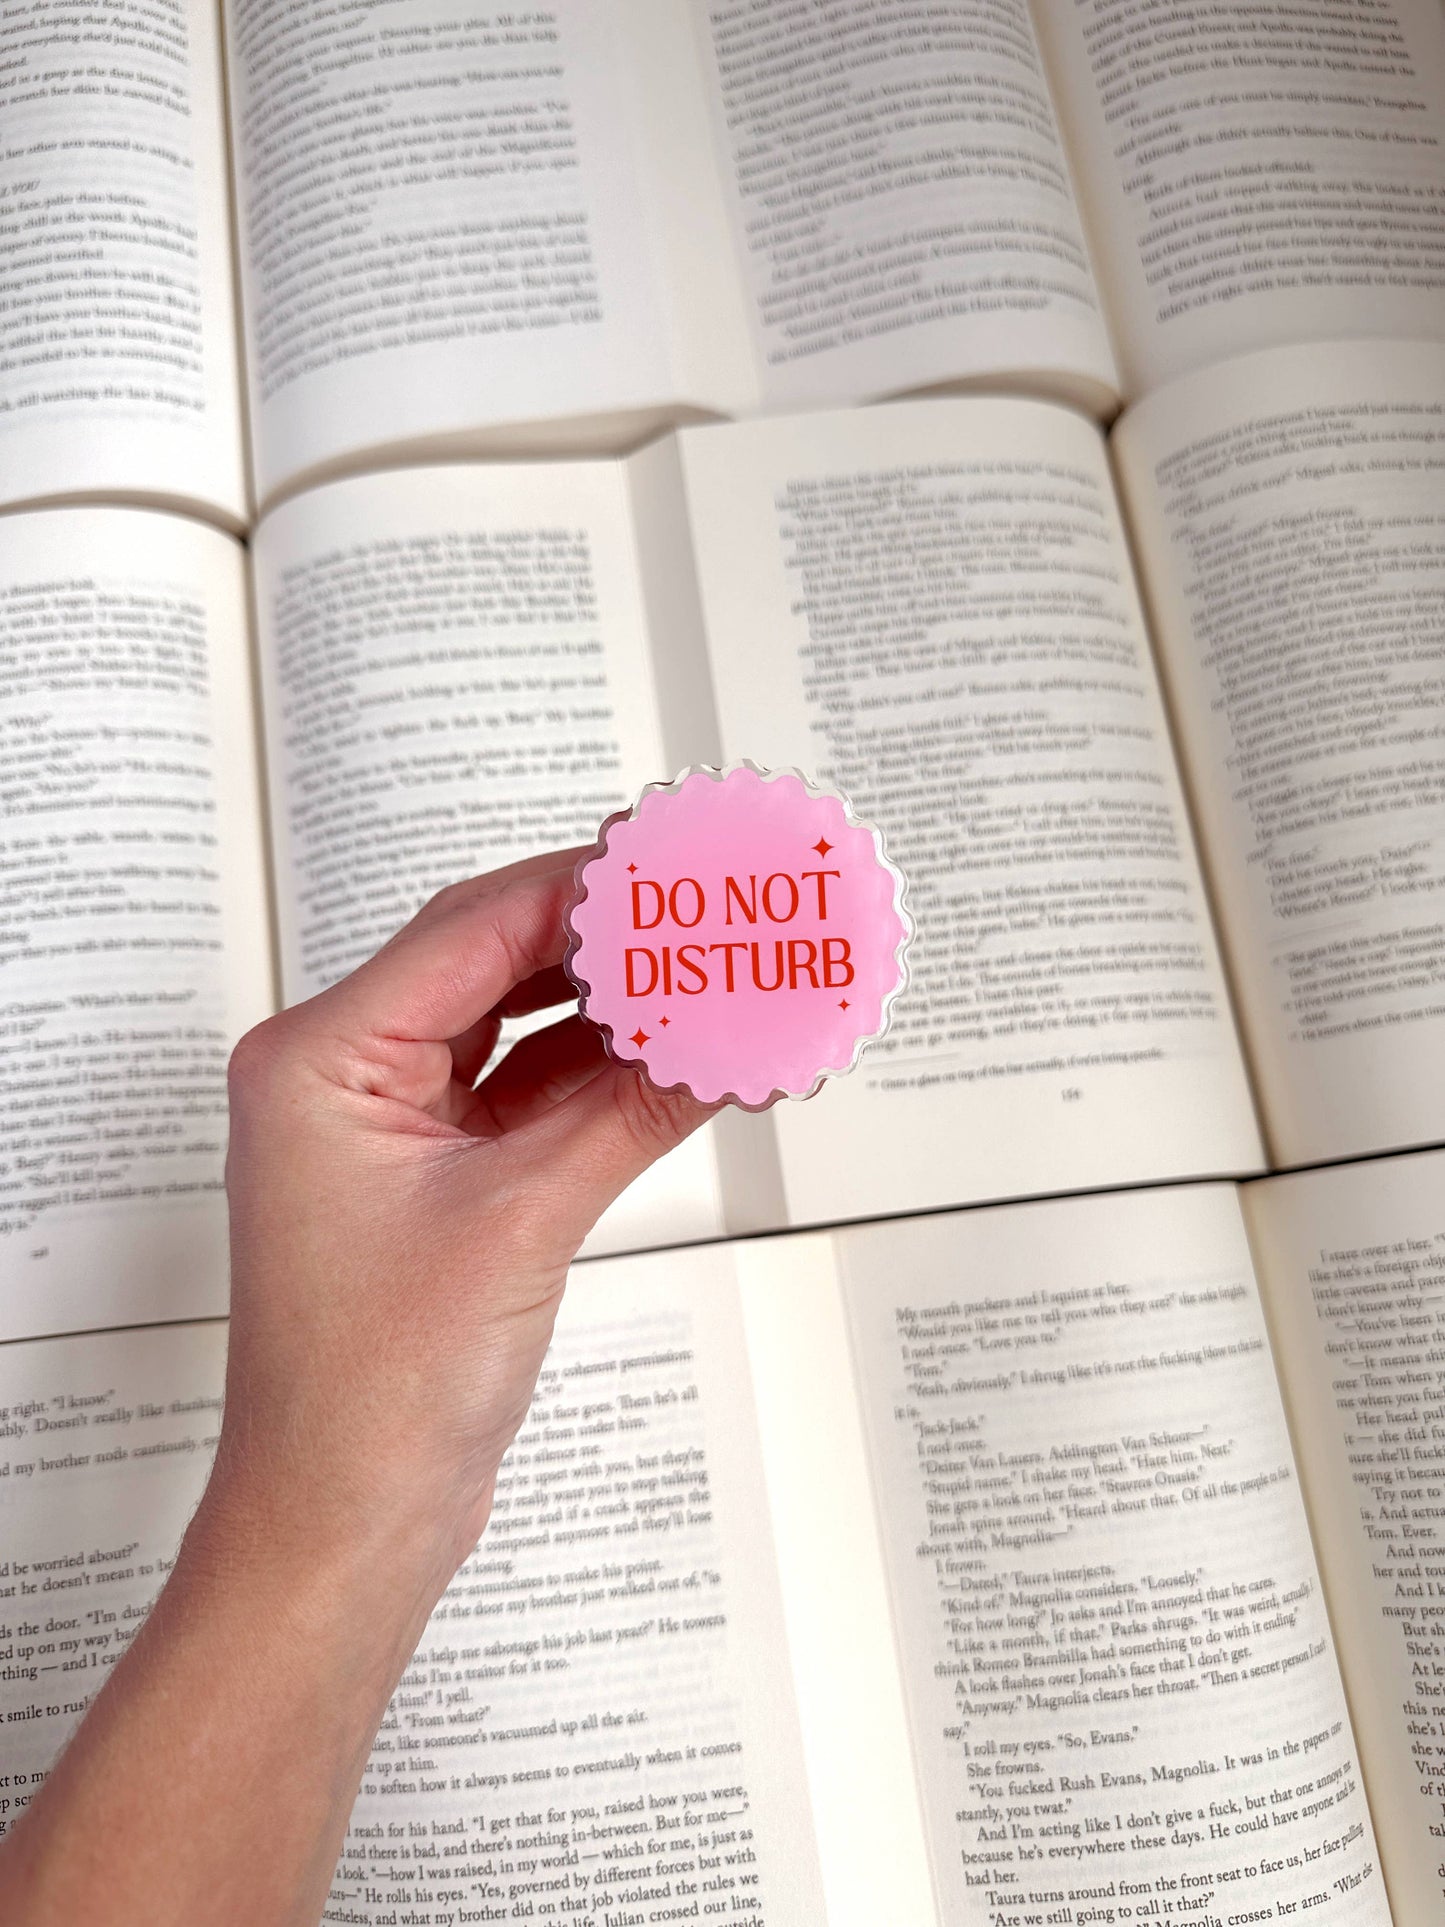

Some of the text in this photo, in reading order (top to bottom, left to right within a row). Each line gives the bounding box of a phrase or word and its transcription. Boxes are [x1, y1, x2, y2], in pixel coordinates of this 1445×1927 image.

[632, 870, 841, 930] DO NOT
[625, 937, 855, 998] DISTURB
[31, 1552, 85, 1573] worried
[87, 1542, 139, 1565] about?”
[17, 1610, 117, 1637] the door. “I’m
[17, 1634, 112, 1661] up on my way
[61, 1652, 97, 1672] and I
[7, 1704, 60, 1722] smile to
[14, 1773, 27, 1786] to
[969, 1783, 1004, 1799] “You
[1008, 1778, 1055, 1796] fucked
[1059, 1774, 1096, 1792] Rush
[1100, 1772, 1147, 1788] Evans,
[1151, 1760, 1220, 1783] Magnolia.
[1224, 1755, 1236, 1770] It
[1239, 1753, 1263, 1766] was
[1267, 1747, 1280, 1761] in
[1283, 1740, 1300, 1756] the
[961, 1784, 1352, 1865] because he’s everywhere these days. He could have anyone and
[977, 1825, 1008, 1842] And
[1011, 1824, 1034, 1840] I’m
[1039, 1821, 1081, 1838] acting
[1084, 1817, 1110, 1834] like
[1115, 1815, 1122, 1830] I
[1127, 1811, 1161, 1829] don’t
[1166, 1809, 1192, 1828] give
[1209, 1799, 1242, 1817] fuck,
[1245, 1796, 1266, 1810] but
[1270, 1789, 1293, 1804] that
[1296, 1782, 1313, 1797] one
[343, 1865, 368, 1881] look.
[418, 1865, 424, 1880] I
[426, 1868, 451, 1880] was
[454, 1860, 497, 1878] raised,
[499, 1860, 514, 1874] in
[517, 1860, 538, 1875] my
[540, 1850, 579, 1869] world
[602, 1841, 644, 1860] which
[647, 1839, 667, 1854] for
[670, 1838, 695, 1851] me,
[698, 1833, 709, 1847] is
[711, 1831, 736, 1849] just
[739, 1830, 753, 1842] as
[365, 1847, 756, 1906] He rolls his eyes. “Yes, governed by different forces but with
[985, 1892, 1026, 1906] Taura
[1029, 1891, 1064, 1904] turns
[1068, 1881, 1116, 1901] around
[1119, 1880, 1152, 1896] from
[1155, 1876, 1177, 1891] the
[1180, 1873, 1213, 1888] front
[1216, 1868, 1241, 1883] seat
[1244, 1867, 1257, 1877] to
[1260, 1859, 1284, 1874] face
[1286, 1856, 1303, 1867] us,
[1304, 1848, 1321, 1861] her
[1323, 1839, 1342, 1855] face
[375, 1874, 758, 1927] and what my brother did on that job violated the rules we
[989, 1913, 1020, 1927] “Are
[1024, 1915, 1043, 1925] we
[1047, 1908, 1073, 1924] still
[1076, 1907, 1115, 1927] going
[1118, 1907, 1132, 1918] to
[1136, 1899, 1160, 1916] call
[1163, 1899, 1173, 1913] it
[1228, 1909, 1272, 1926] crosses
[1277, 1901, 1296, 1916] her
[1301, 1892, 1331, 1909] arms.
